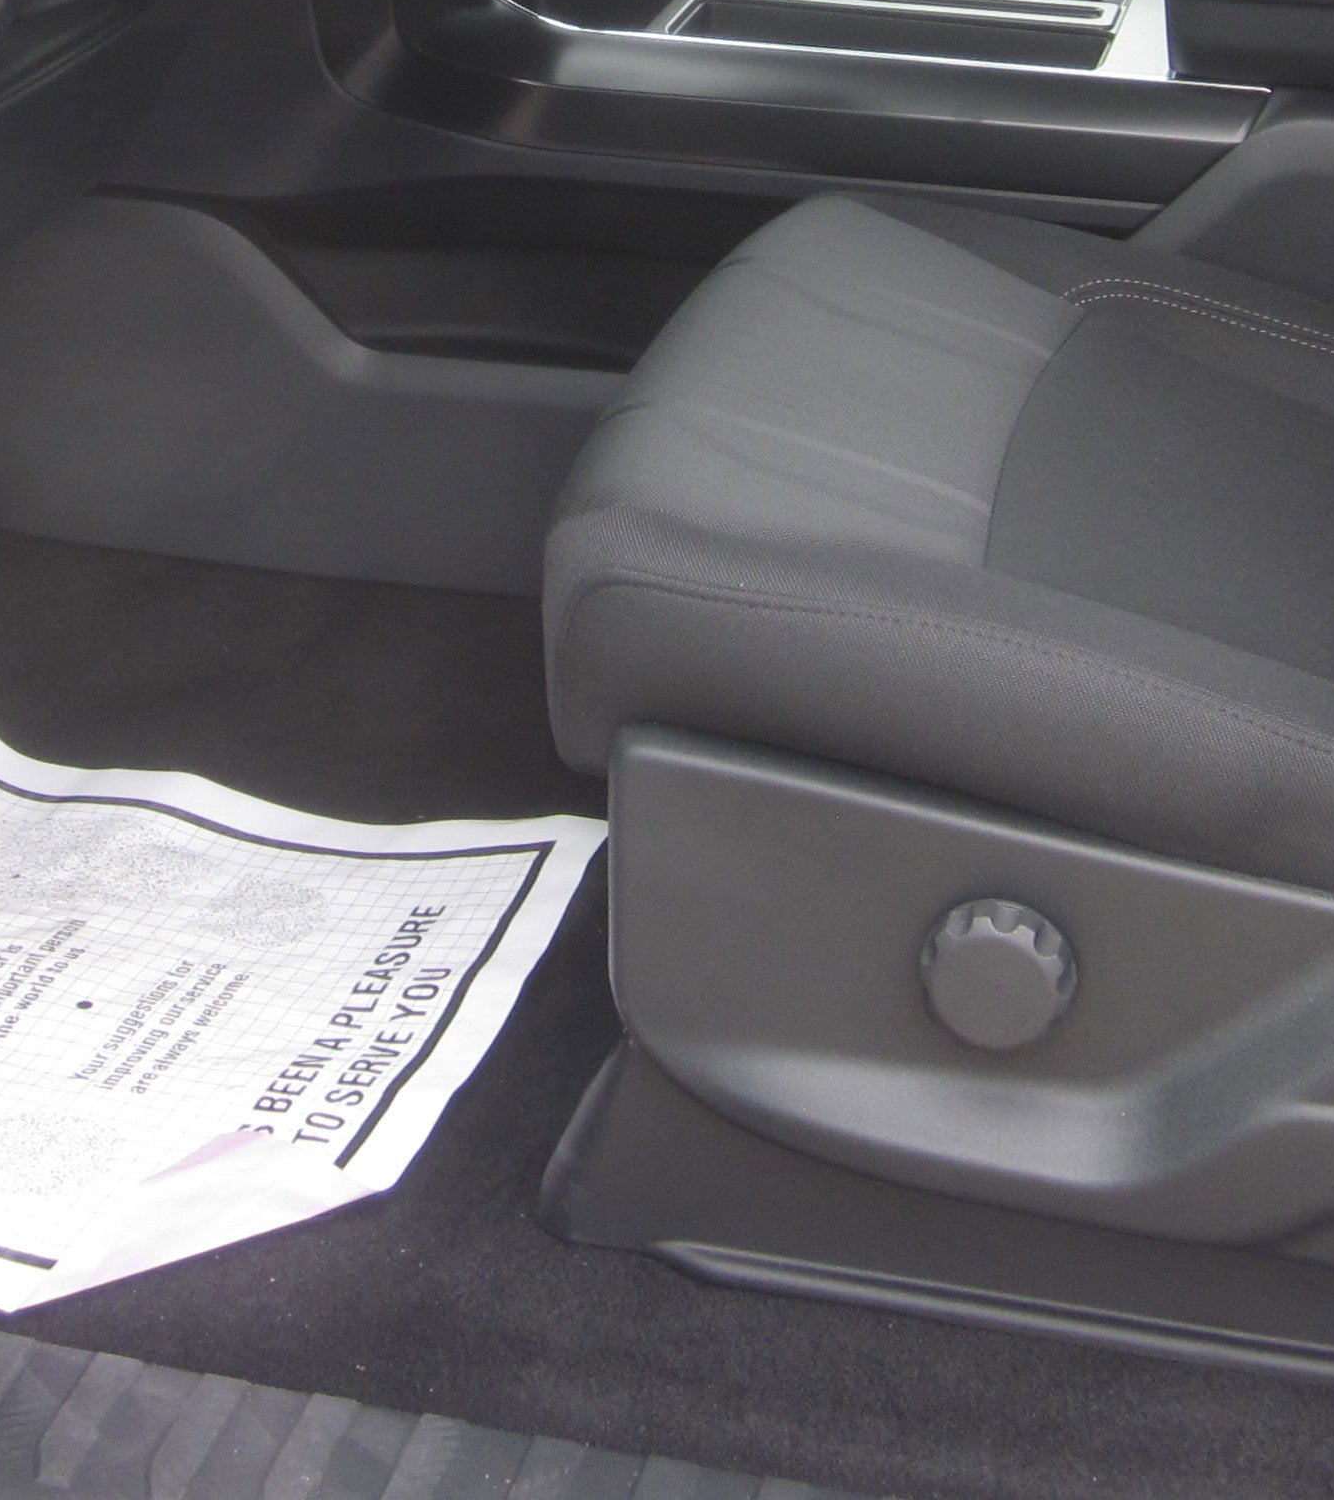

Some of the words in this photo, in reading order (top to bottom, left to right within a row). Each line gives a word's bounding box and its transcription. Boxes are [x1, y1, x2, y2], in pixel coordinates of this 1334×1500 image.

[0, 944, 23, 954] is
[39, 919, 87, 952] person
[14, 975, 55, 1010] world
[46, 961, 68, 974] to
[330, 905, 447, 1029] PLEASURE
[68, 1053, 110, 1081] Your
[103, 980, 179, 1051] suggestions
[168, 959, 195, 979] for
[94, 1029, 170, 1091] improving
[159, 1003, 186, 1026] our
[180, 963, 227, 1004] service
[312, 1037, 352, 1052] A
[130, 1072, 159, 1095] are
[153, 1029, 201, 1072] always
[253, 1054, 334, 1113] BEEN
[291, 1111, 346, 1144] TO
[325, 1031, 414, 1106] SERVE
[390, 968, 452, 1021] YOU
